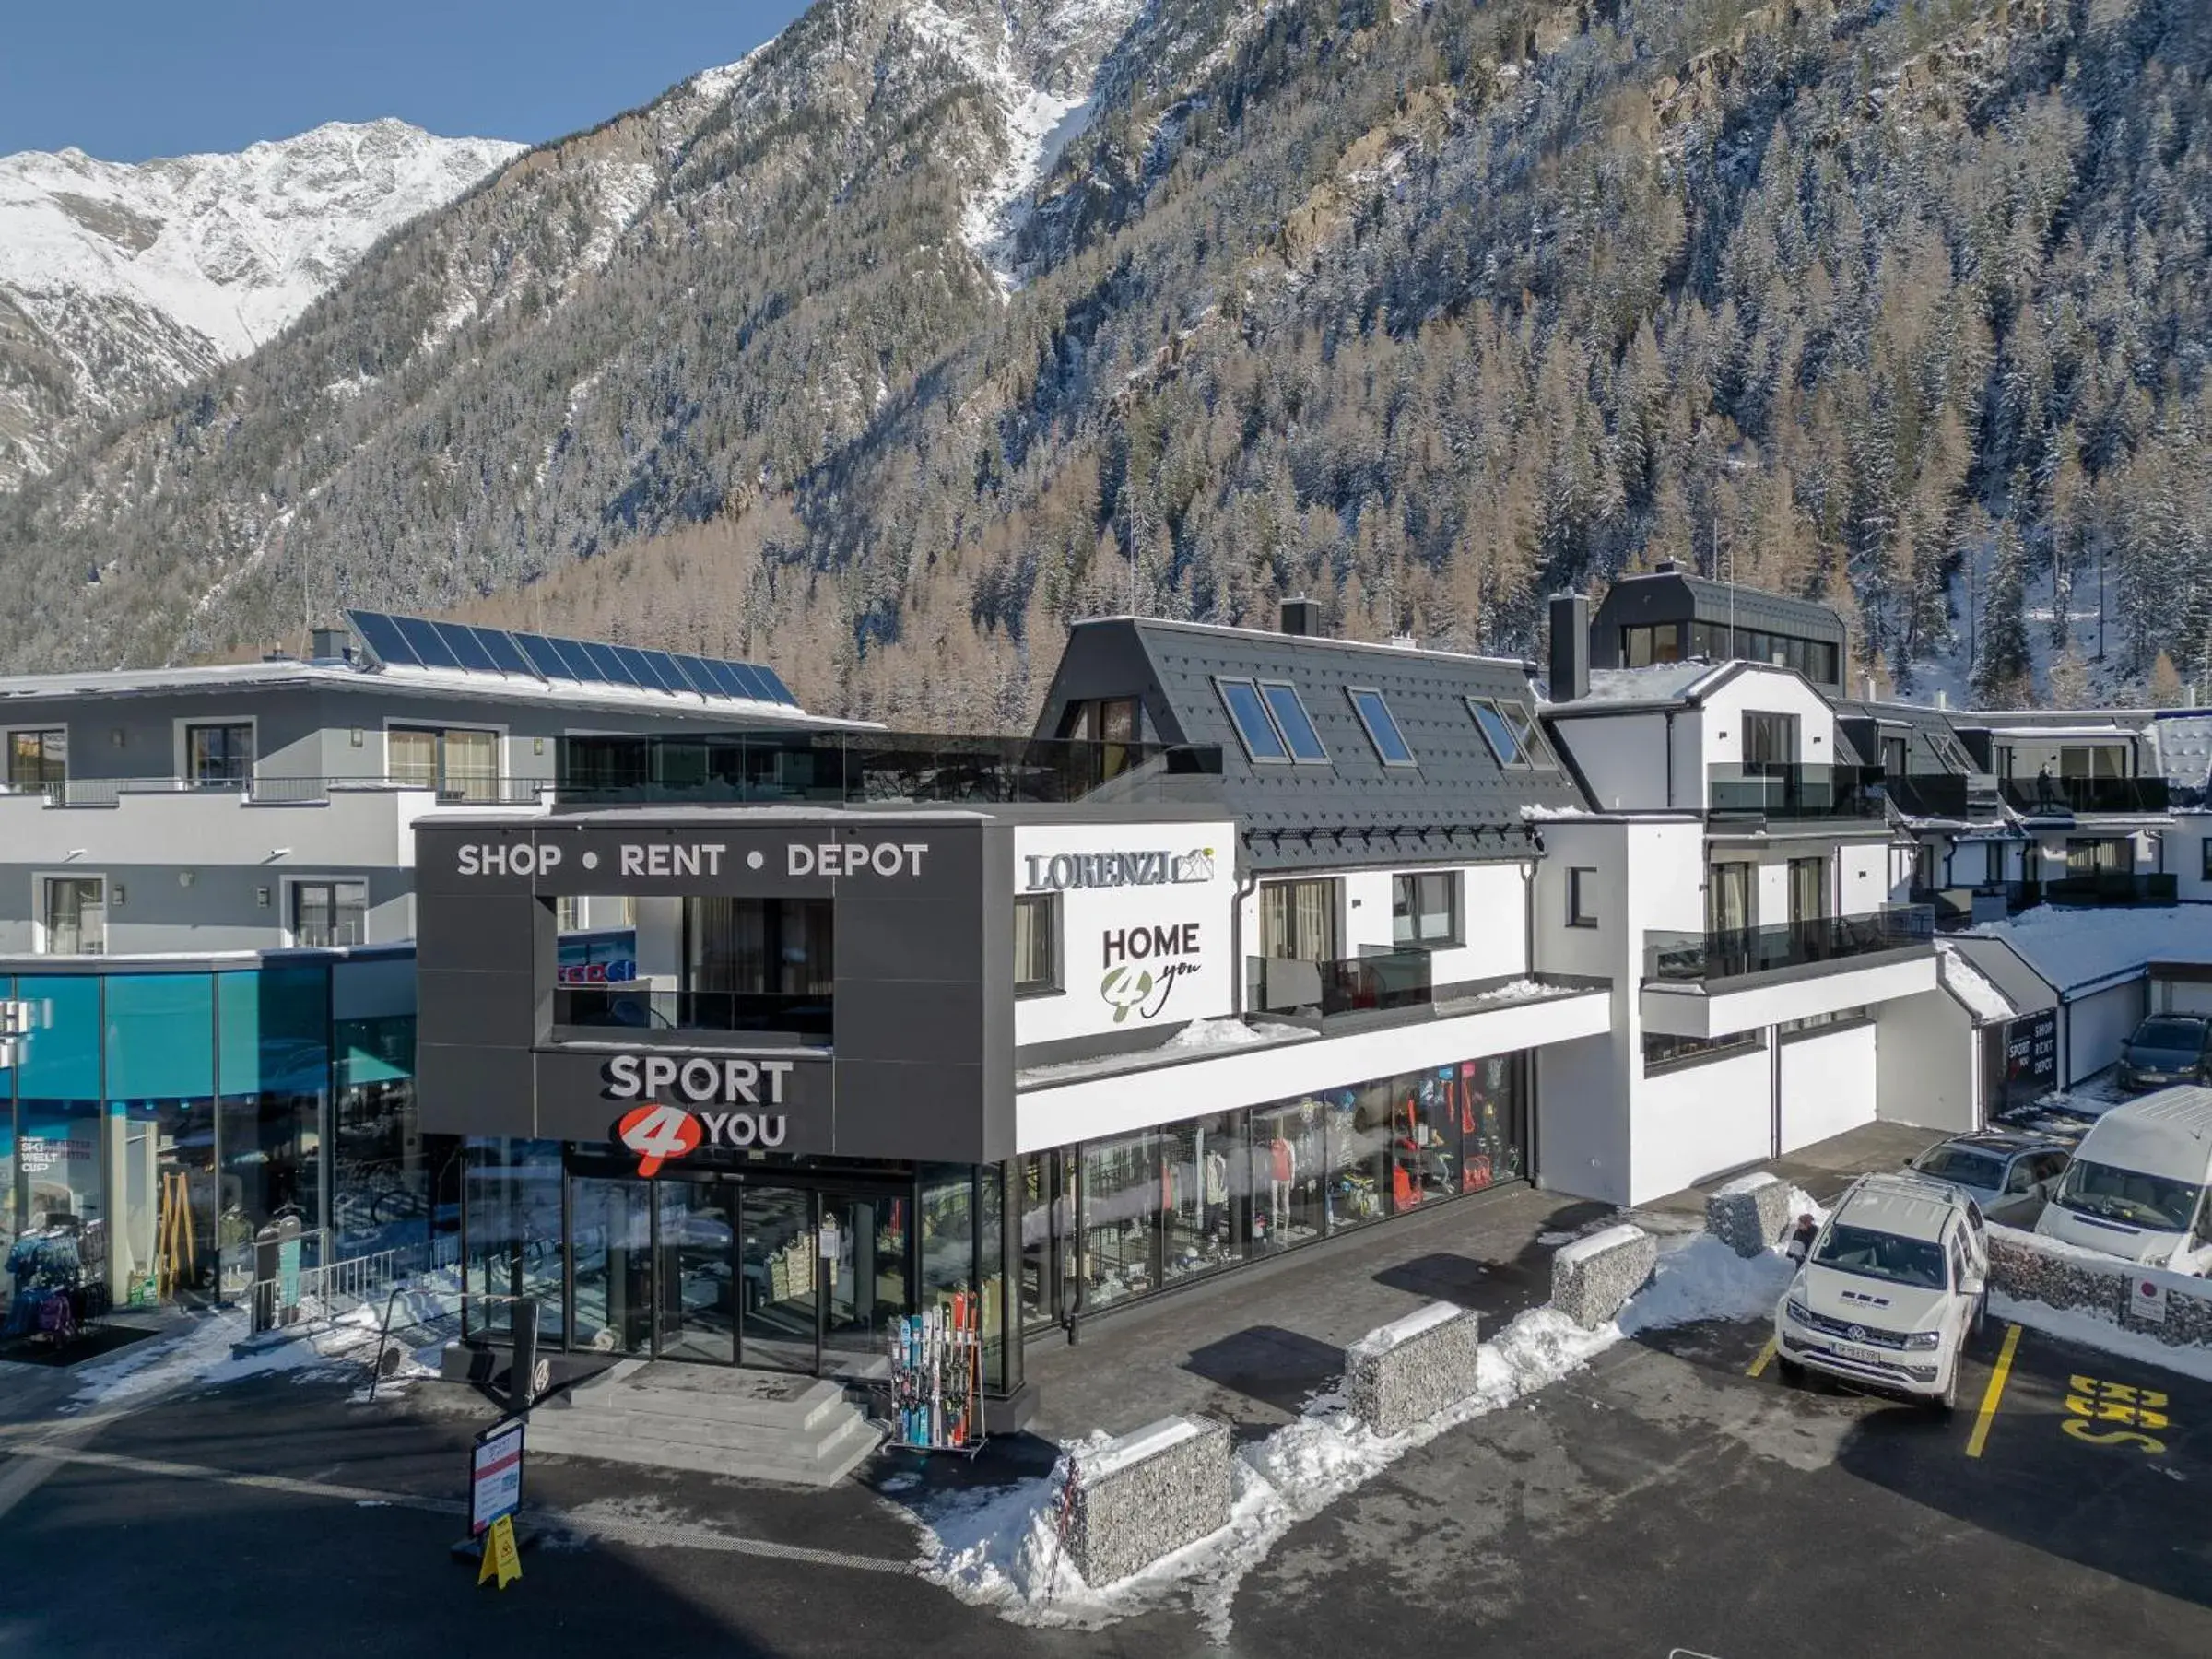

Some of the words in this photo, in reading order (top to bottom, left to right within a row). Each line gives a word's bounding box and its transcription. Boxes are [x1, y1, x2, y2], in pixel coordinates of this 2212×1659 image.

[458, 843, 561, 876] SHOP
[620, 844, 725, 876] RENT
[788, 843, 929, 876] DEPOT
[1025, 851, 1171, 890] LORENZI
[1103, 923, 1200, 969] HOME
[1140, 962, 1202, 1018] you
[610, 1055, 794, 1103] SPORT
[620, 1105, 688, 1177] 4
[700, 1112, 786, 1147] YOU
